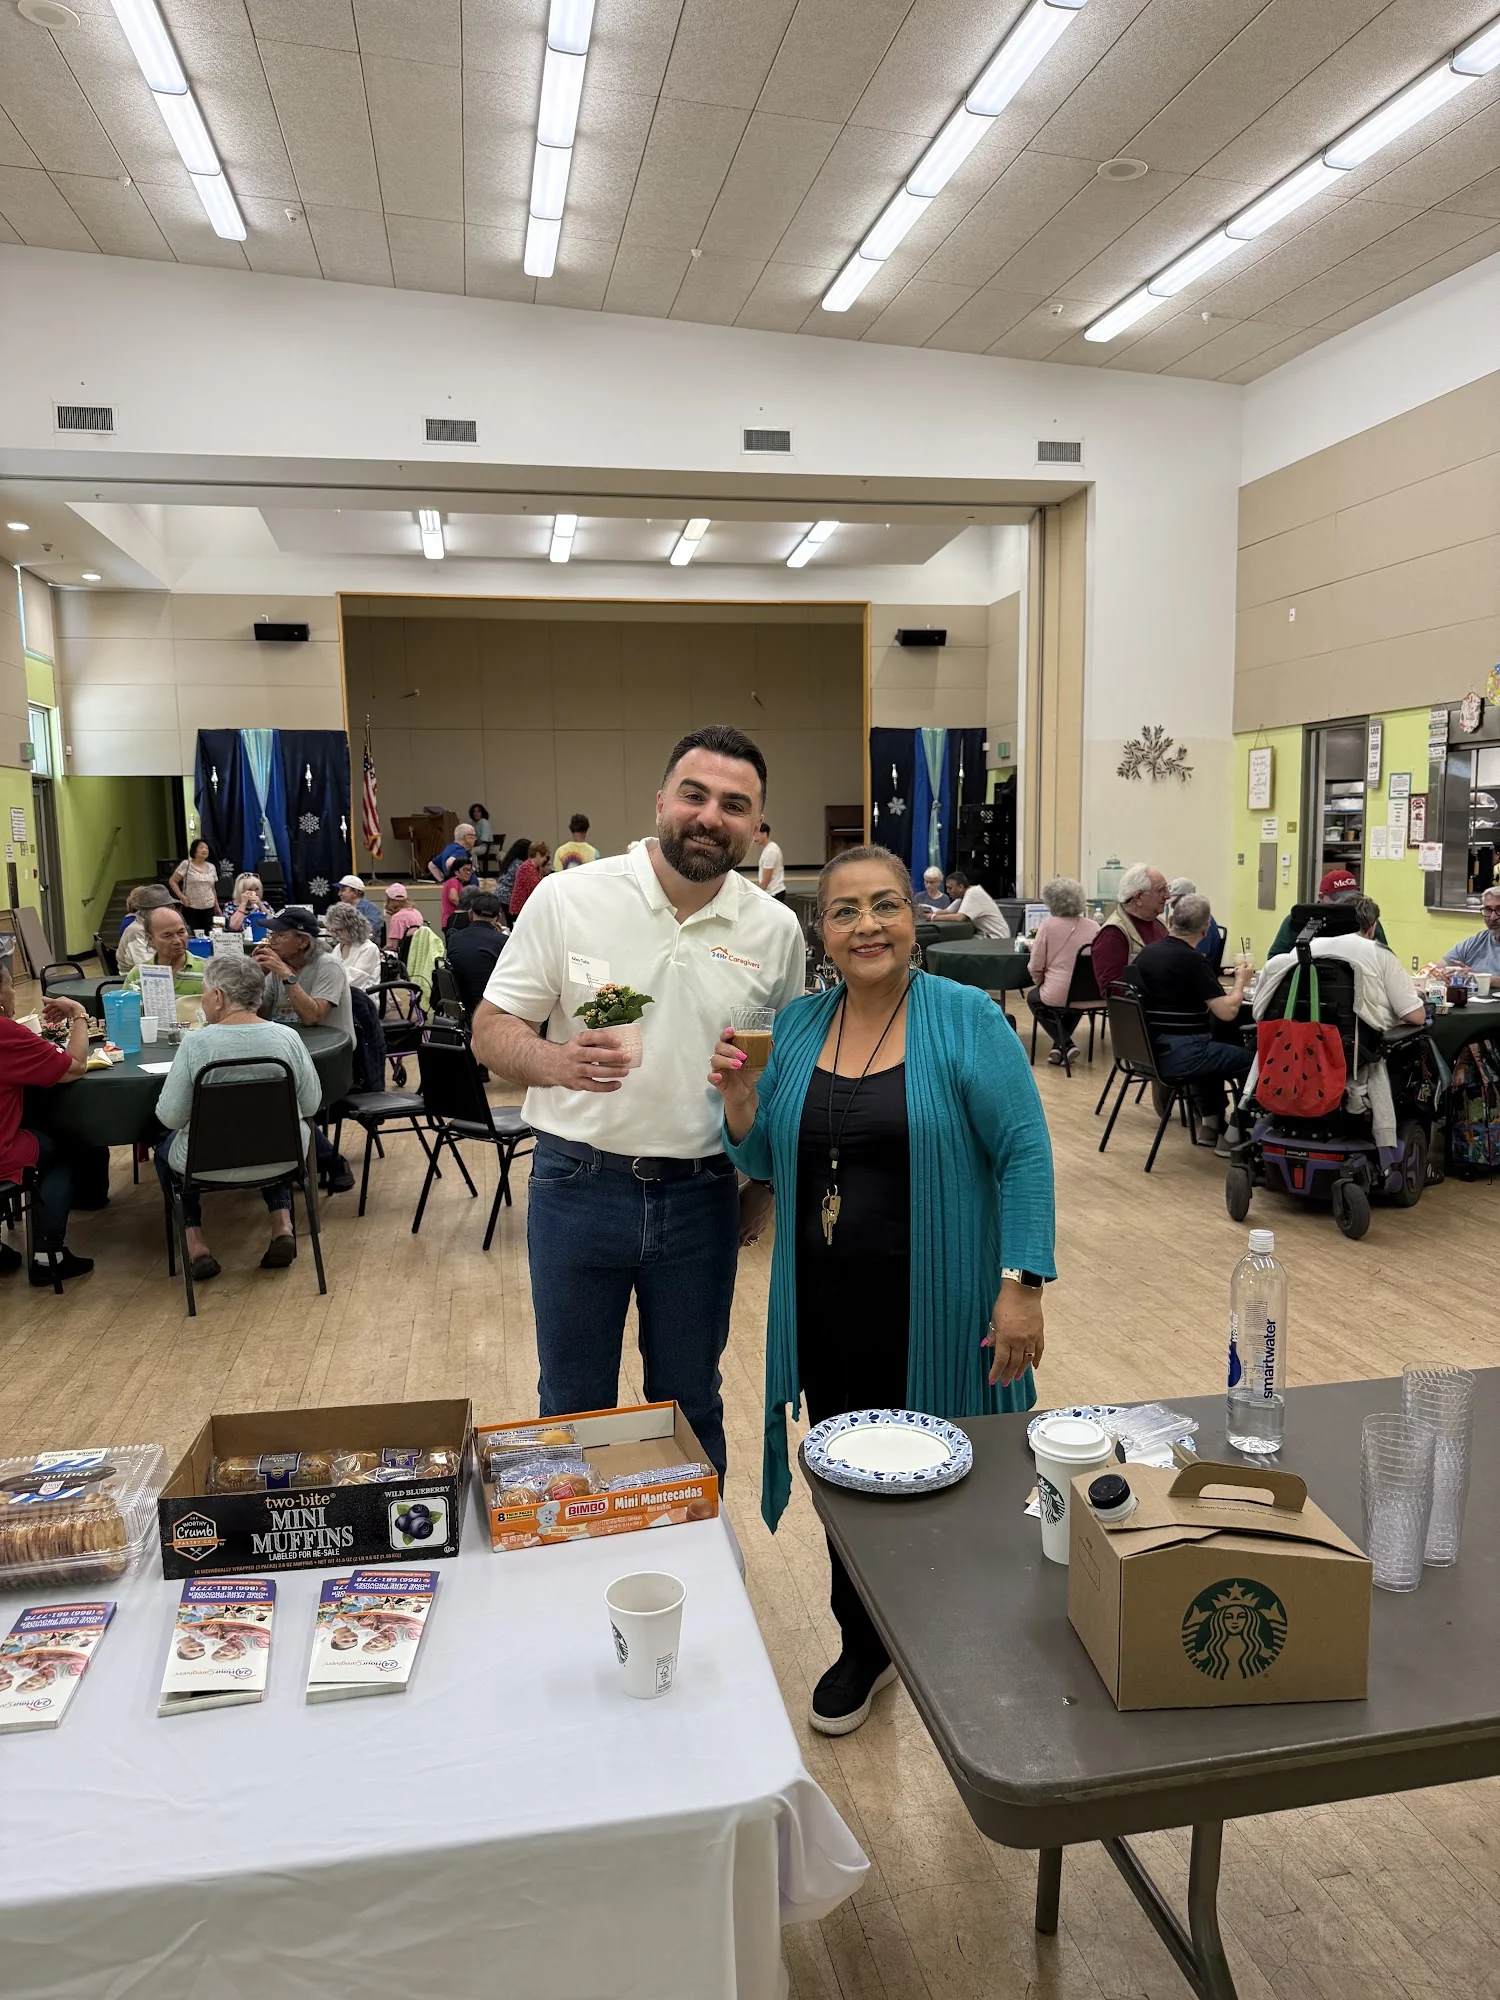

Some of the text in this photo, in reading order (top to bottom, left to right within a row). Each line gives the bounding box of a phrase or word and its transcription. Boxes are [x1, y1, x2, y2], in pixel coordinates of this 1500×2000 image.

[711, 951, 760, 969] 24Hr Caregivers
[1263, 1318, 1276, 1399] smartwater
[384, 1485, 451, 1498] WILD BLUEBERRY
[614, 1486, 703, 1511] Mini Mantecadas
[567, 1501, 606, 1516] BIMBO
[270, 1506, 327, 1532] MINI
[497, 1512, 506, 1523] 8
[181, 1521, 208, 1529] WORTHY
[176, 1526, 214, 1539] Crumb
[251, 1525, 354, 1555] MUFFINS
[268, 1548, 340, 1562] LABELED FOR RE-SALE
[232, 1565, 255, 1573] WRAPPED
[24, 1610, 70, 1621] 681-7778
[71, 1609, 96, 1617] (866)
